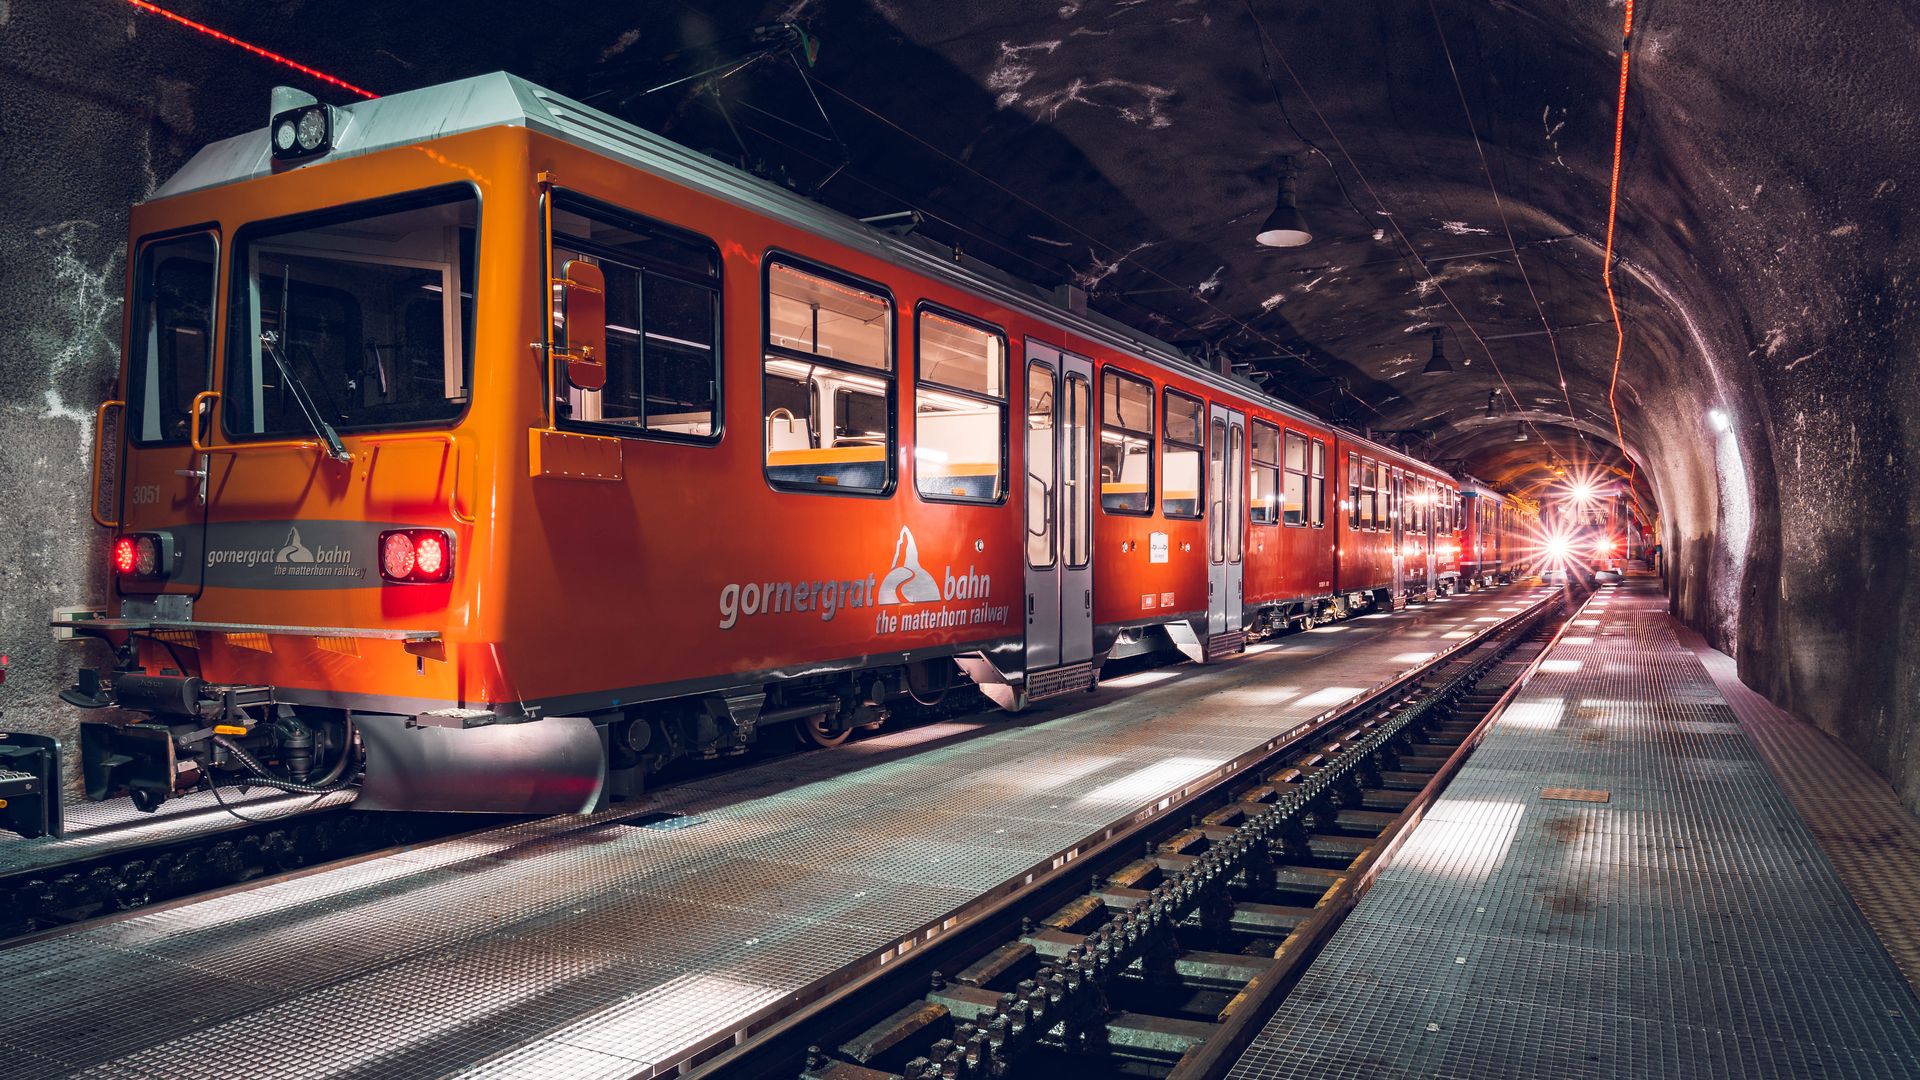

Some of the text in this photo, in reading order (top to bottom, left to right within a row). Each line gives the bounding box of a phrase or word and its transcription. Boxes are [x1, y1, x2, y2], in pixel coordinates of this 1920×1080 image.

[133, 485, 160, 504] 3051
[208, 545, 351, 567] gornergrat bahn
[274, 564, 367, 579] the matterhorn railway
[719, 565, 991, 629] gornergrat bahn
[876, 602, 1009, 634] the matterhorn railway
